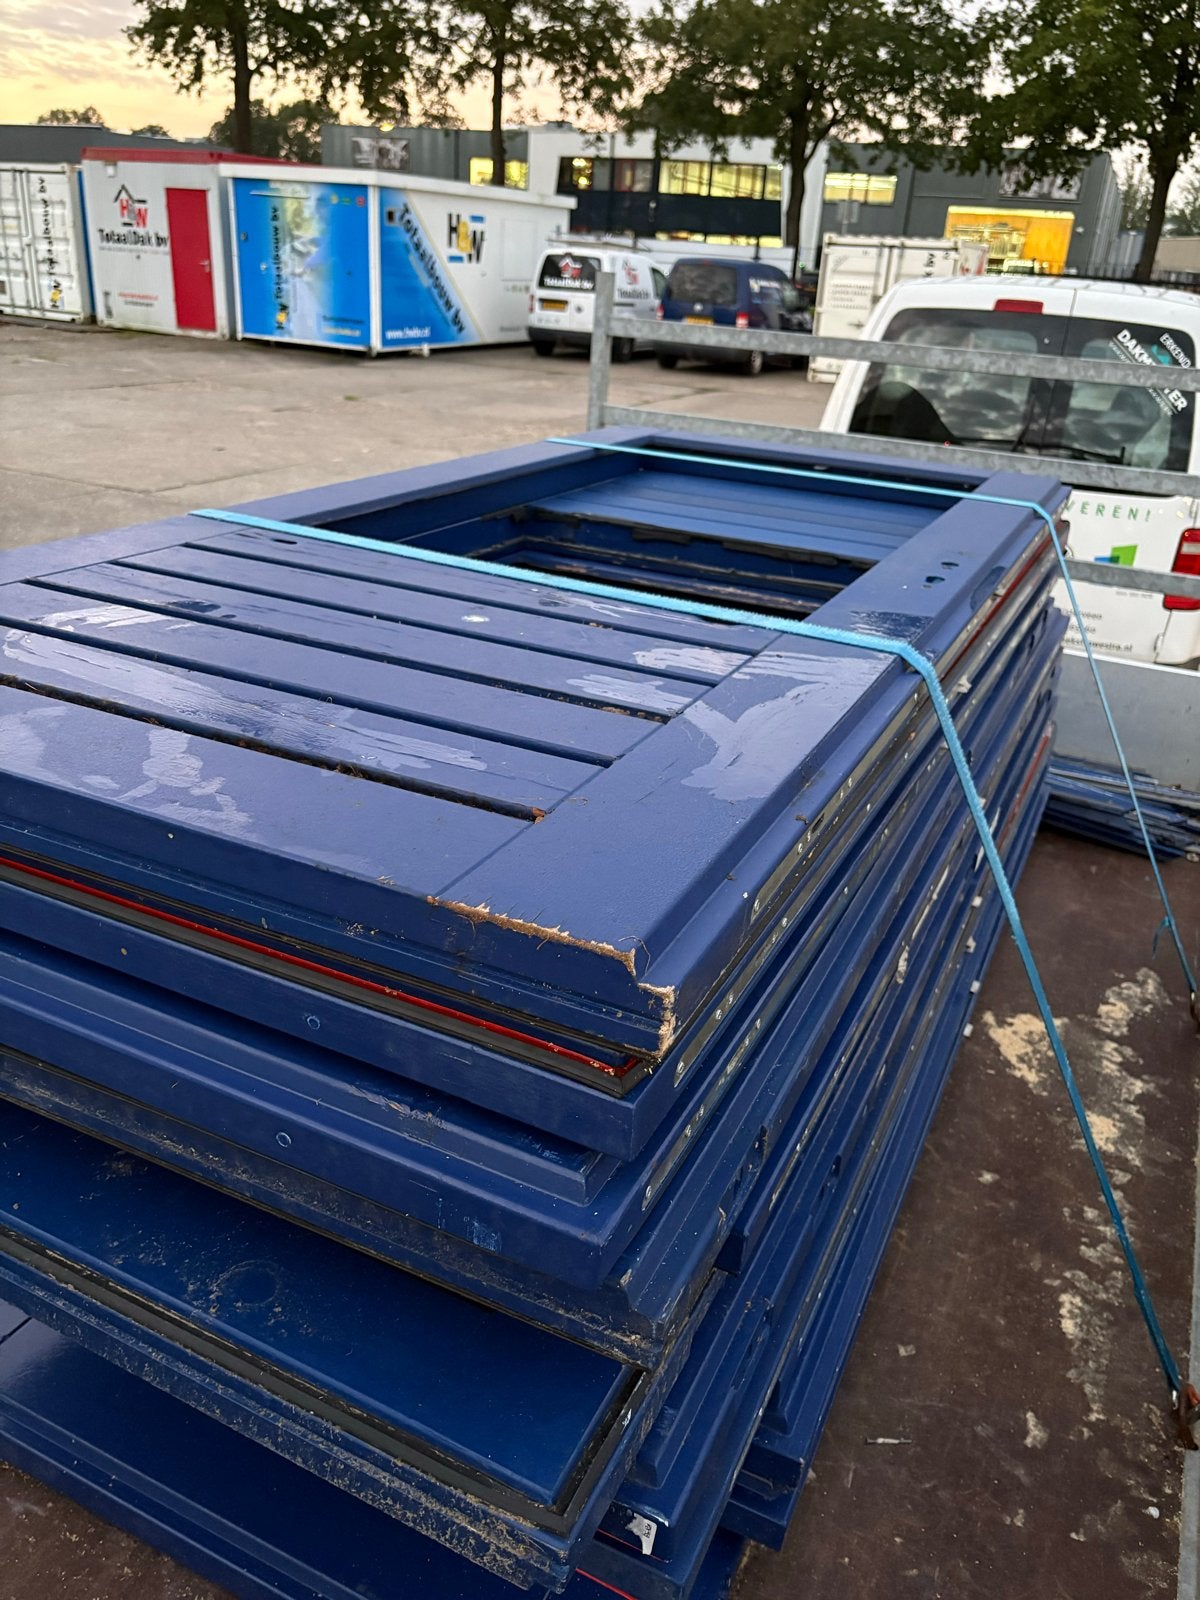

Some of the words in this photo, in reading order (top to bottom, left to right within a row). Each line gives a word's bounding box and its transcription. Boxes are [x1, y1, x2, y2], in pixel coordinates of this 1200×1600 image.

[398, 202, 455, 312] Totaalbouw
[447, 212, 486, 264] H&W
[1115, 328, 1189, 413] DAKMER
[1159, 332, 1193, 369] ERKEND
